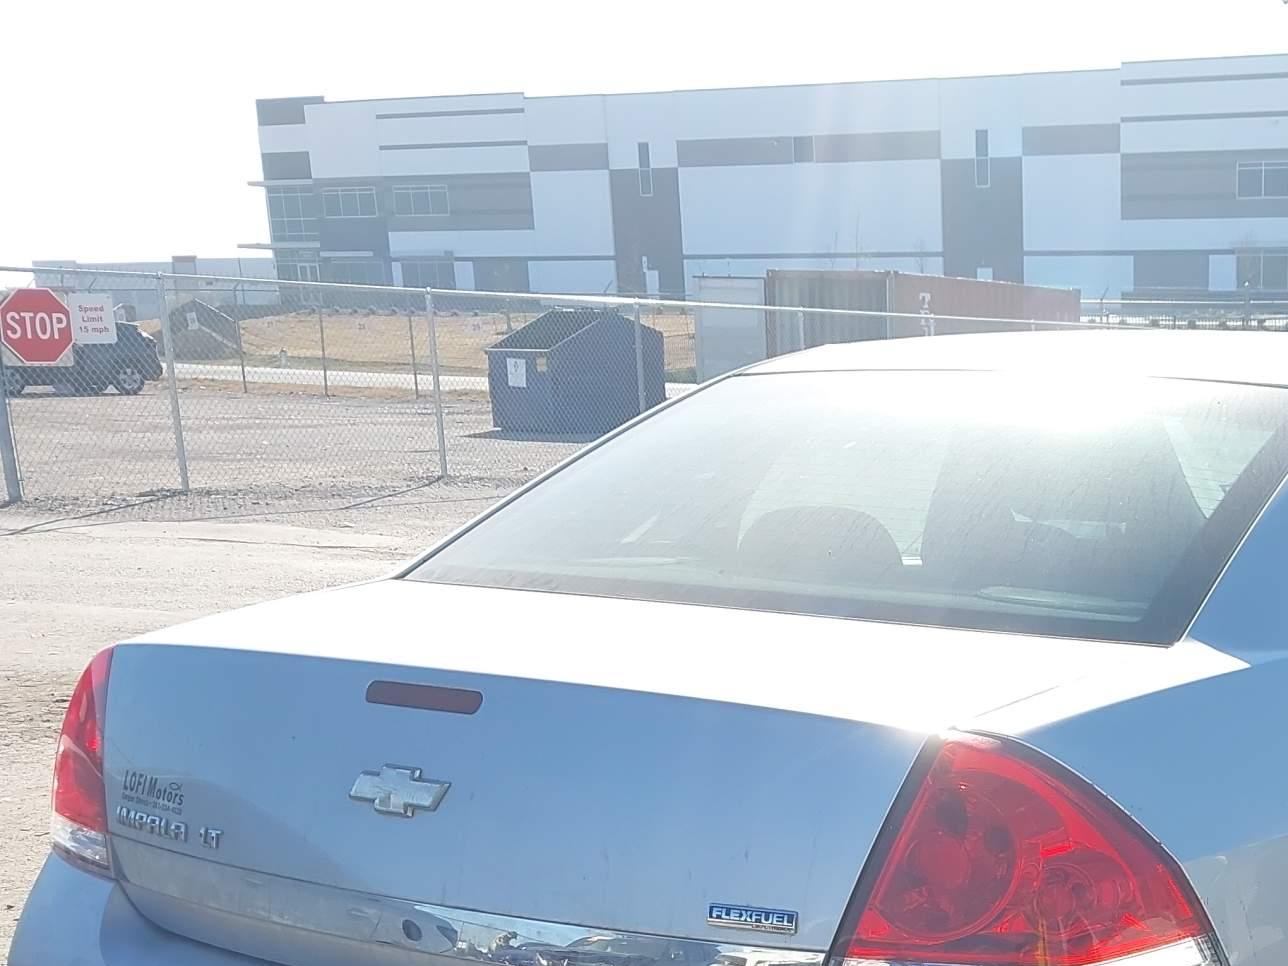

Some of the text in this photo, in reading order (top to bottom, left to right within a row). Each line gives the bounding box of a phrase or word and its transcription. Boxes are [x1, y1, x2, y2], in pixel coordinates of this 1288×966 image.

[78, 305, 104, 313] Speed
[82, 315, 103, 323] Limit
[6, 311, 67, 340] STOP
[80, 326, 110, 335] 15 mph
[123, 769, 147, 795] LOFI
[147, 776, 184, 806] Motors
[116, 805, 188, 842] IMPALA
[200, 827, 224, 849] LT
[711, 906, 793, 926] FLEXFUEL
